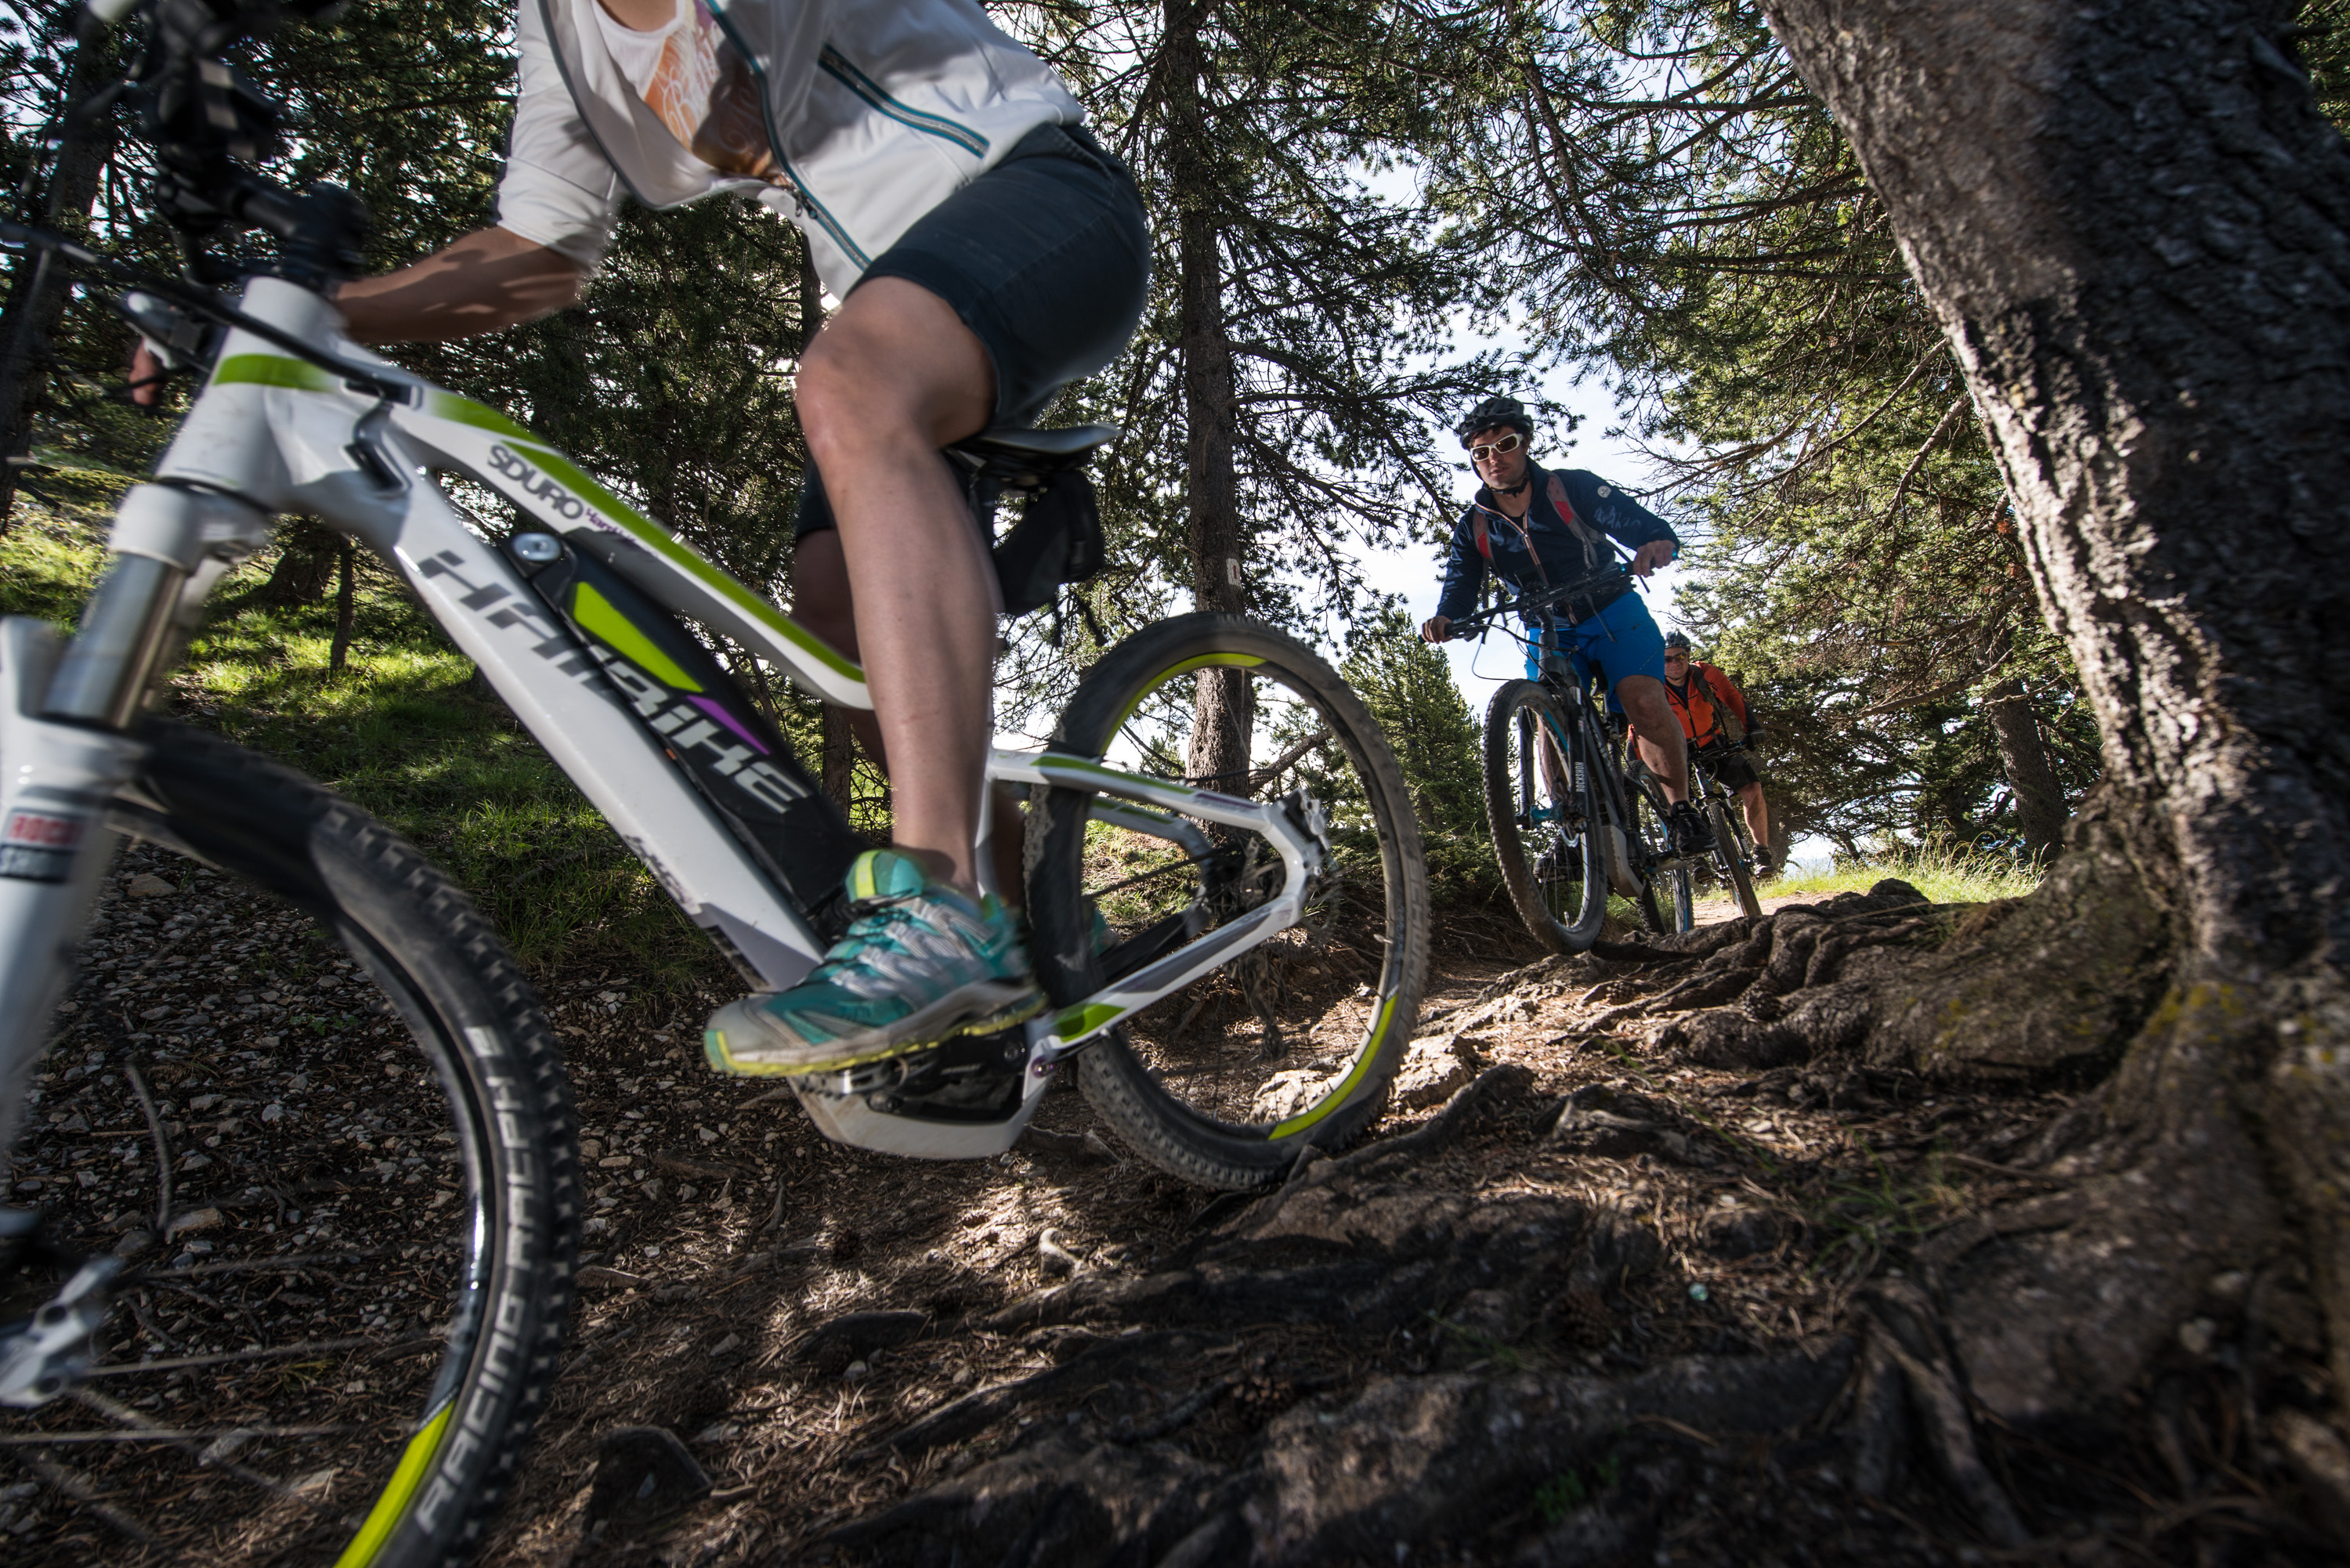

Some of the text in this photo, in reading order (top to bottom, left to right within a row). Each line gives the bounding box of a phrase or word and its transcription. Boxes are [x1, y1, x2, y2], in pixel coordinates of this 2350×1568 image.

[487, 444, 584, 520] SDURO
[1574, 761, 1585, 793] ROCKSHOX
[415, 1075, 536, 1535] RACING RALPH
